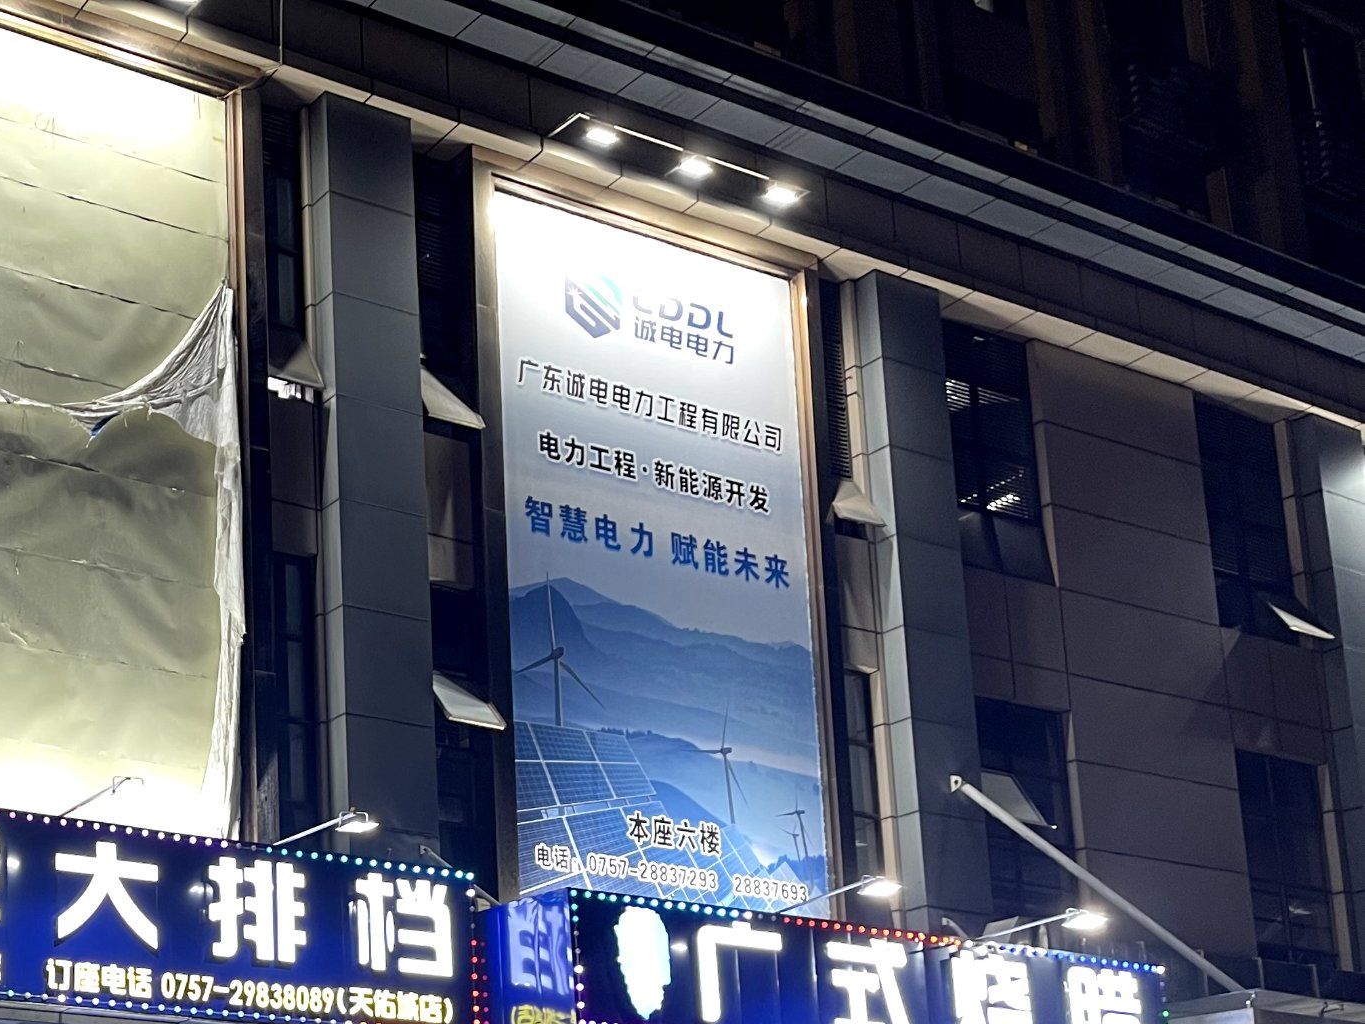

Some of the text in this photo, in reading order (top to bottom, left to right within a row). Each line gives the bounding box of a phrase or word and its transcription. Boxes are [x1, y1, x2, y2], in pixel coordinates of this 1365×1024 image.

[633, 316, 735, 365] 诚电电力
[518, 359, 783, 451] 广东诚电电力工程有限公司
[524, 495, 790, 589] 智慧电力 赋能未来
[628, 812, 721, 854] 本座六楼
[733, 876, 809, 902] 28837693
[45, 958, 153, 999] 订座电话
